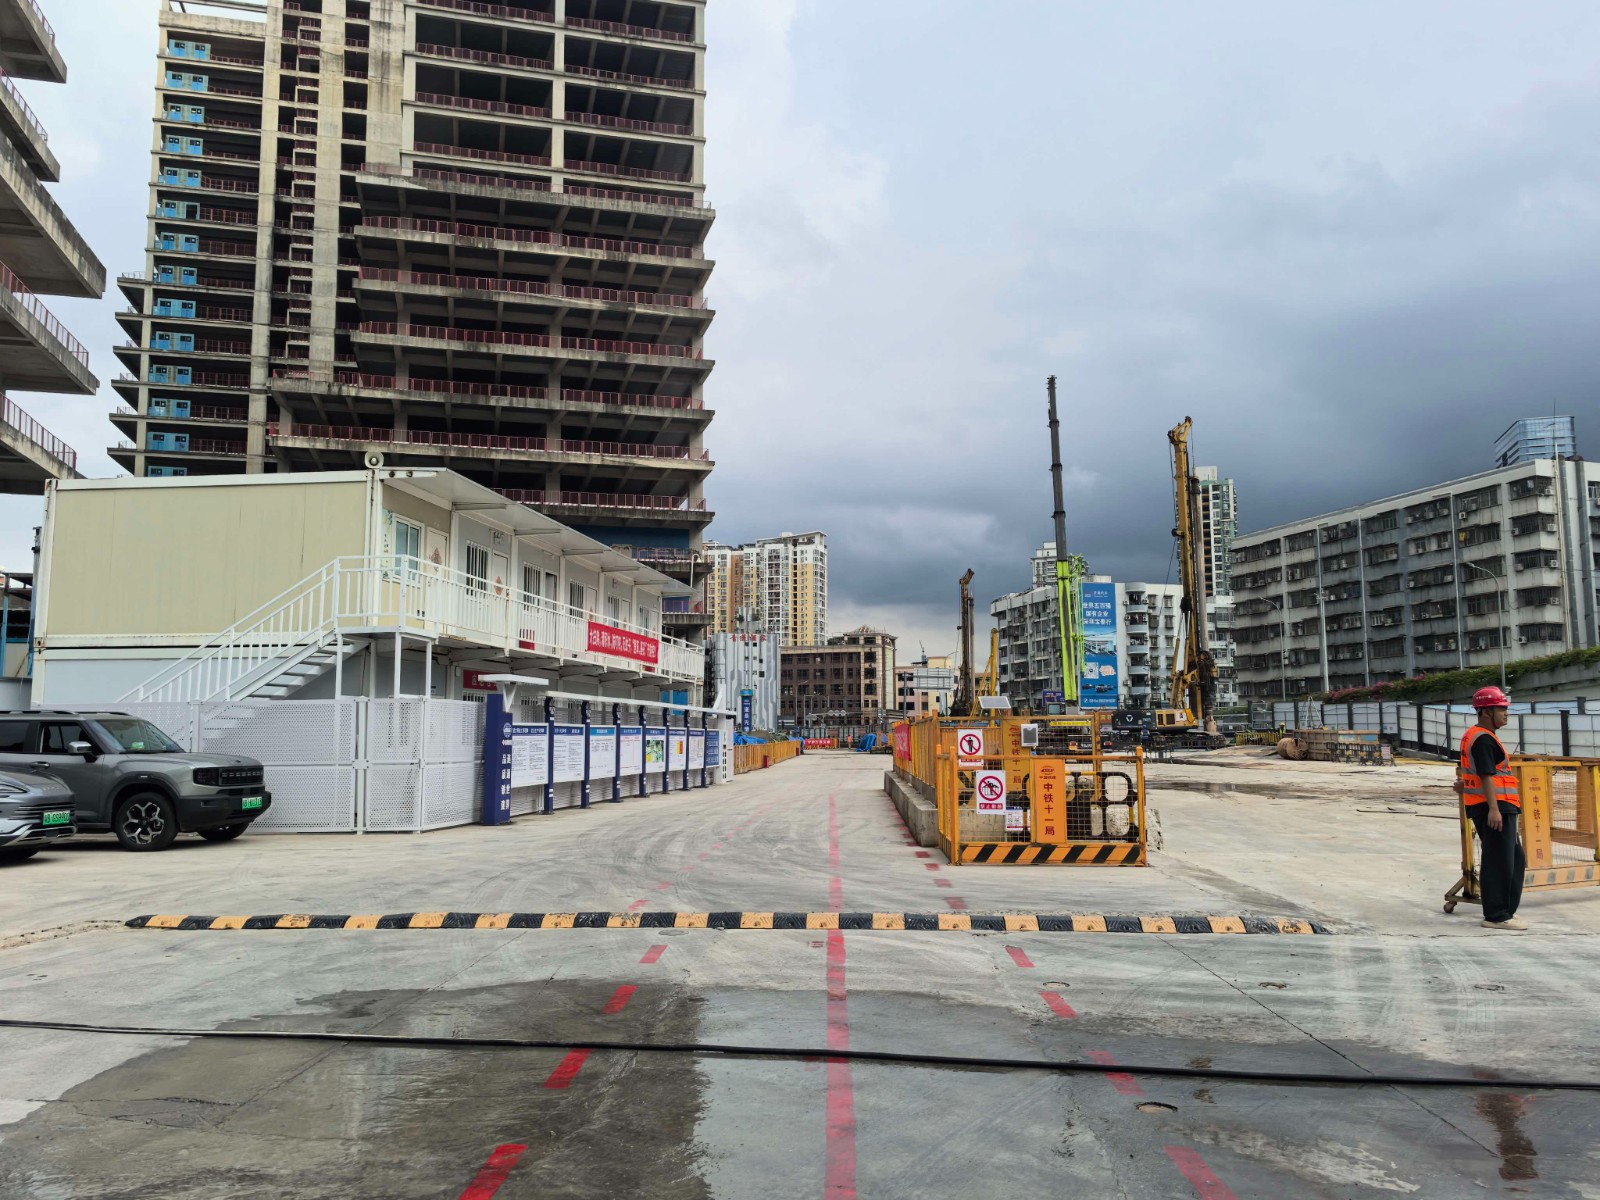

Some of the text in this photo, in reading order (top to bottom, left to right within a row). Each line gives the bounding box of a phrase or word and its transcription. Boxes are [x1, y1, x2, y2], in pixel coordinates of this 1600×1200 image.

[1011, 739, 1022, 784] 中铁十一局
[1043, 782, 1055, 836] 中铁十一局
[1532, 794, 1544, 860] 中铁十一局
